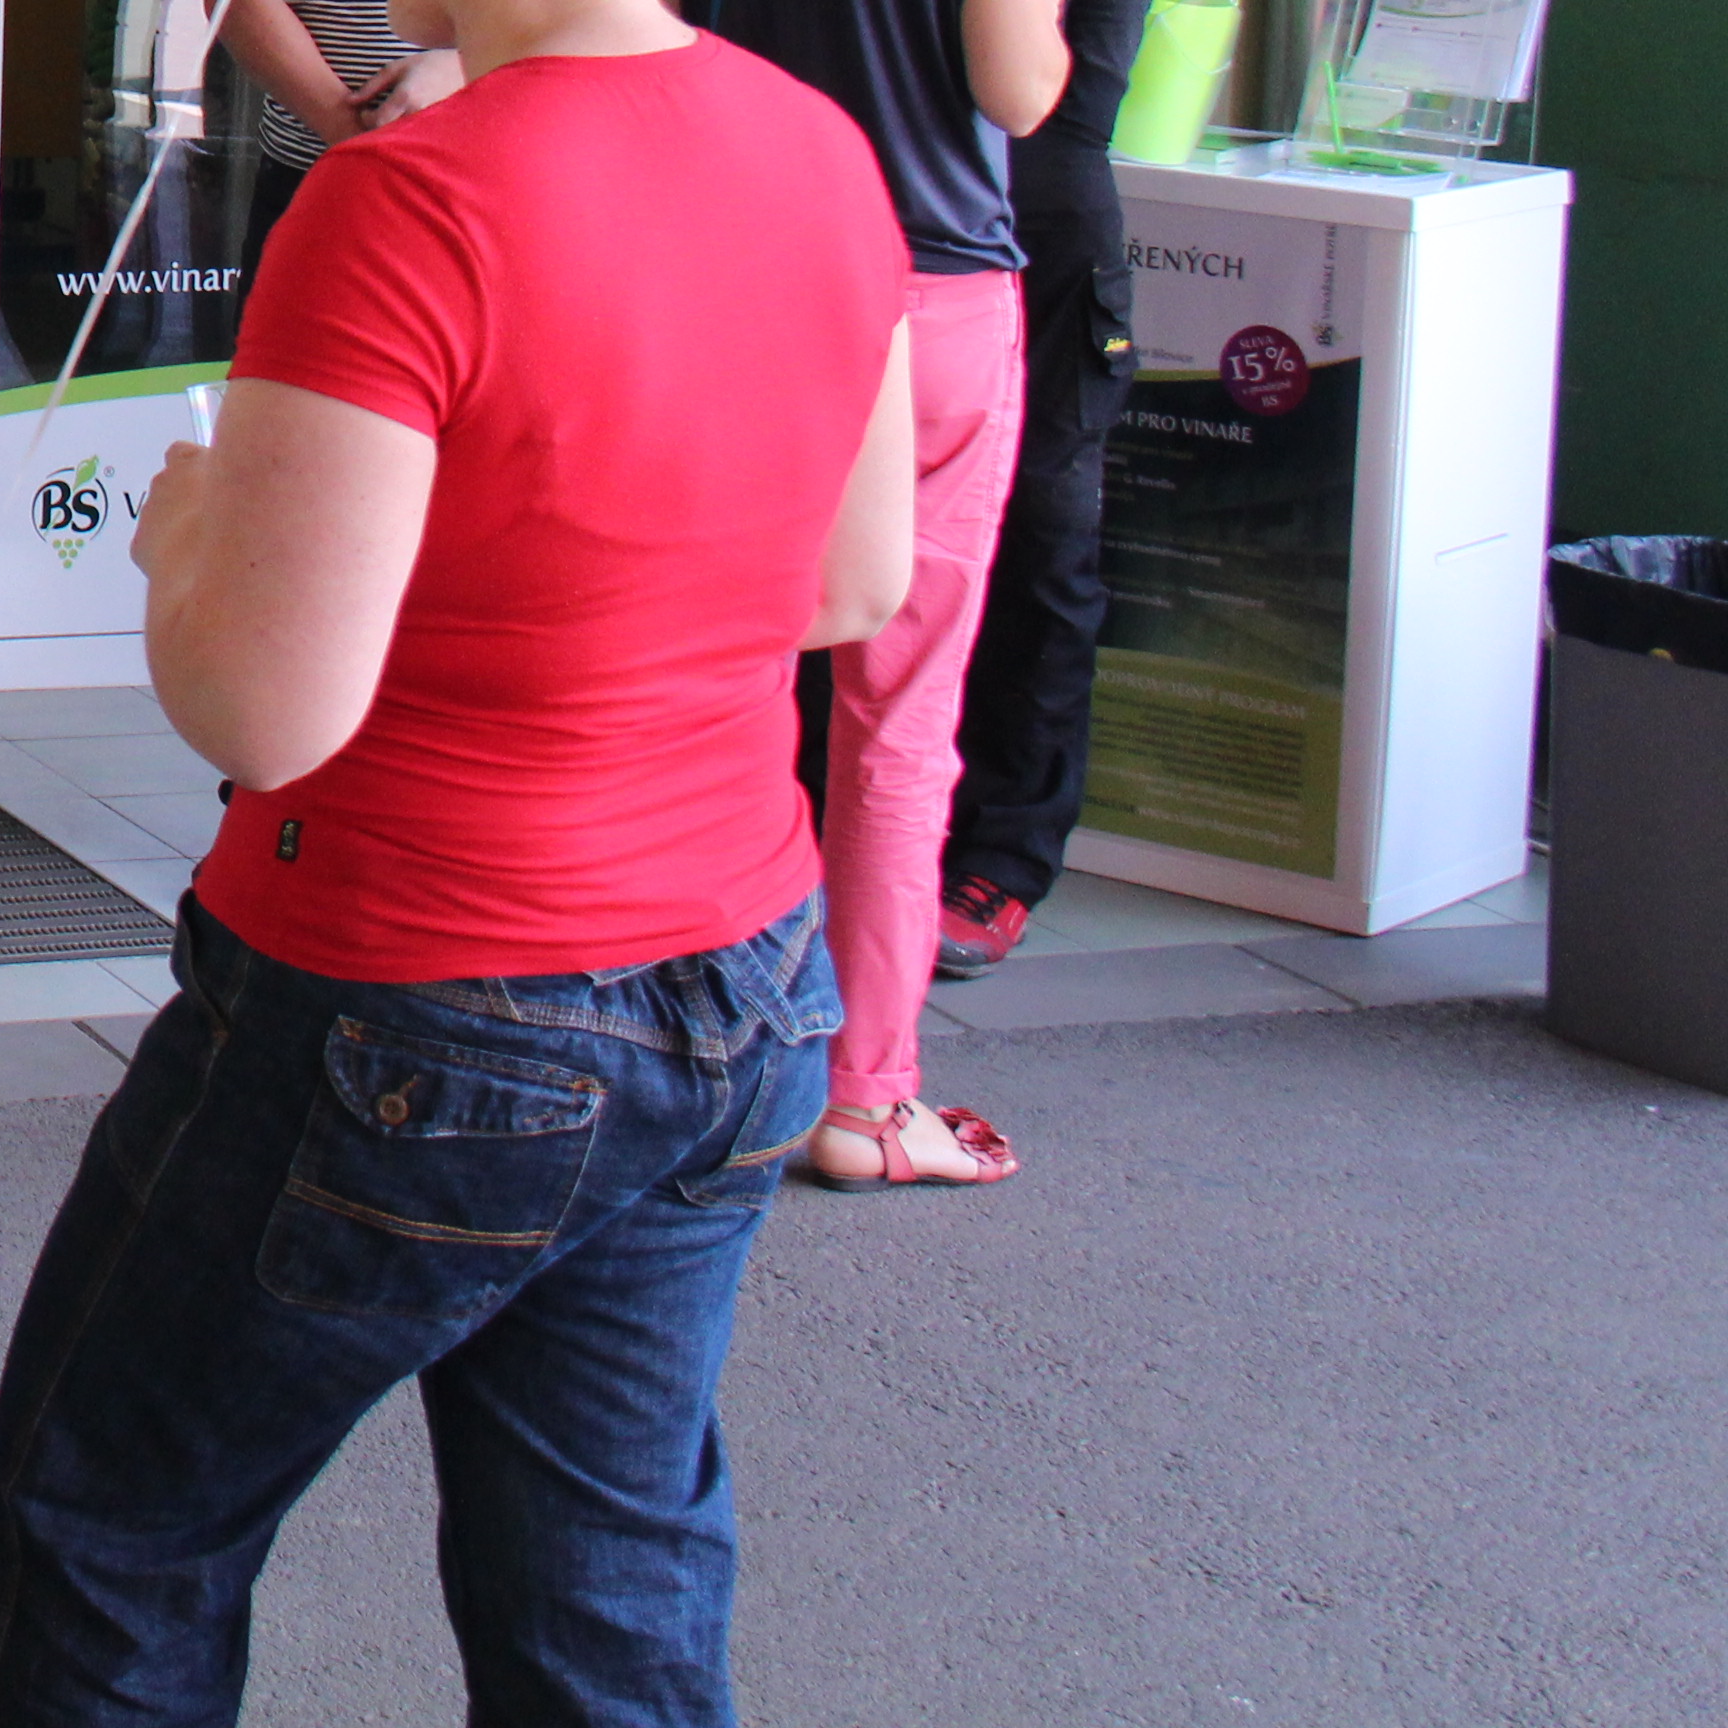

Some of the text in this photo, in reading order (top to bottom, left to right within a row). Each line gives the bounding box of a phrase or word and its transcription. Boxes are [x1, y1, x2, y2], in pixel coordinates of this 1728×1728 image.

[1122, 239, 1244, 280] ŘENÝCH
[57, 262, 241, 297] www.vinar
[1138, 413, 1176, 432] PRO
[1181, 418, 1254, 445] VINAŘE
[34, 479, 100, 533] BS
